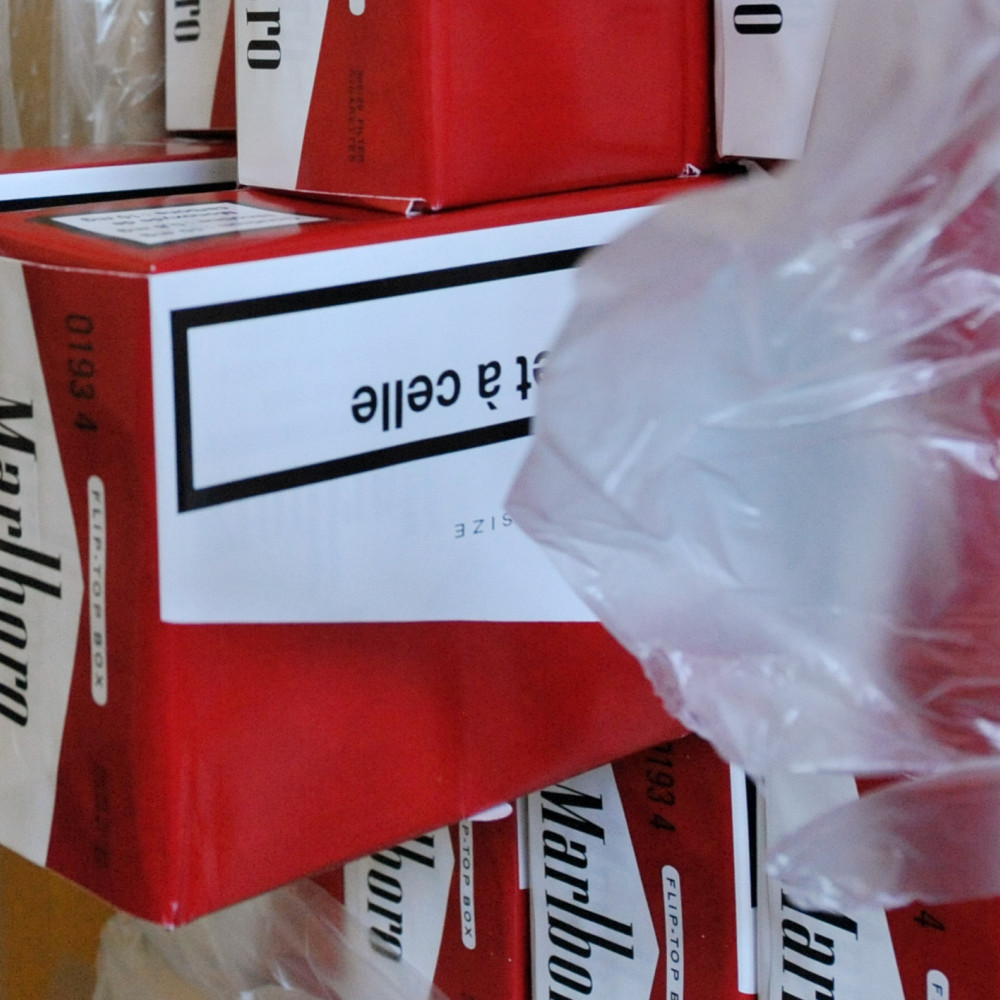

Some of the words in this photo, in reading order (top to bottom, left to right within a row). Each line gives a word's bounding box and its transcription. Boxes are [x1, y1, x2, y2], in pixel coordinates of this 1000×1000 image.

[66, 314, 96, 400] 0193
[351, 368, 462, 433] celle
[477, 360, 502, 411] à
[74, 412, 98, 433] 4
[454, 512, 513, 539] SIZE
[92, 488, 103, 619] FLIP-TOP
[93, 632, 104, 687] BOX
[650, 813, 676, 833] 4
[463, 896, 473, 938] BOX
[666, 876, 680, 982] FLIP-TOP
